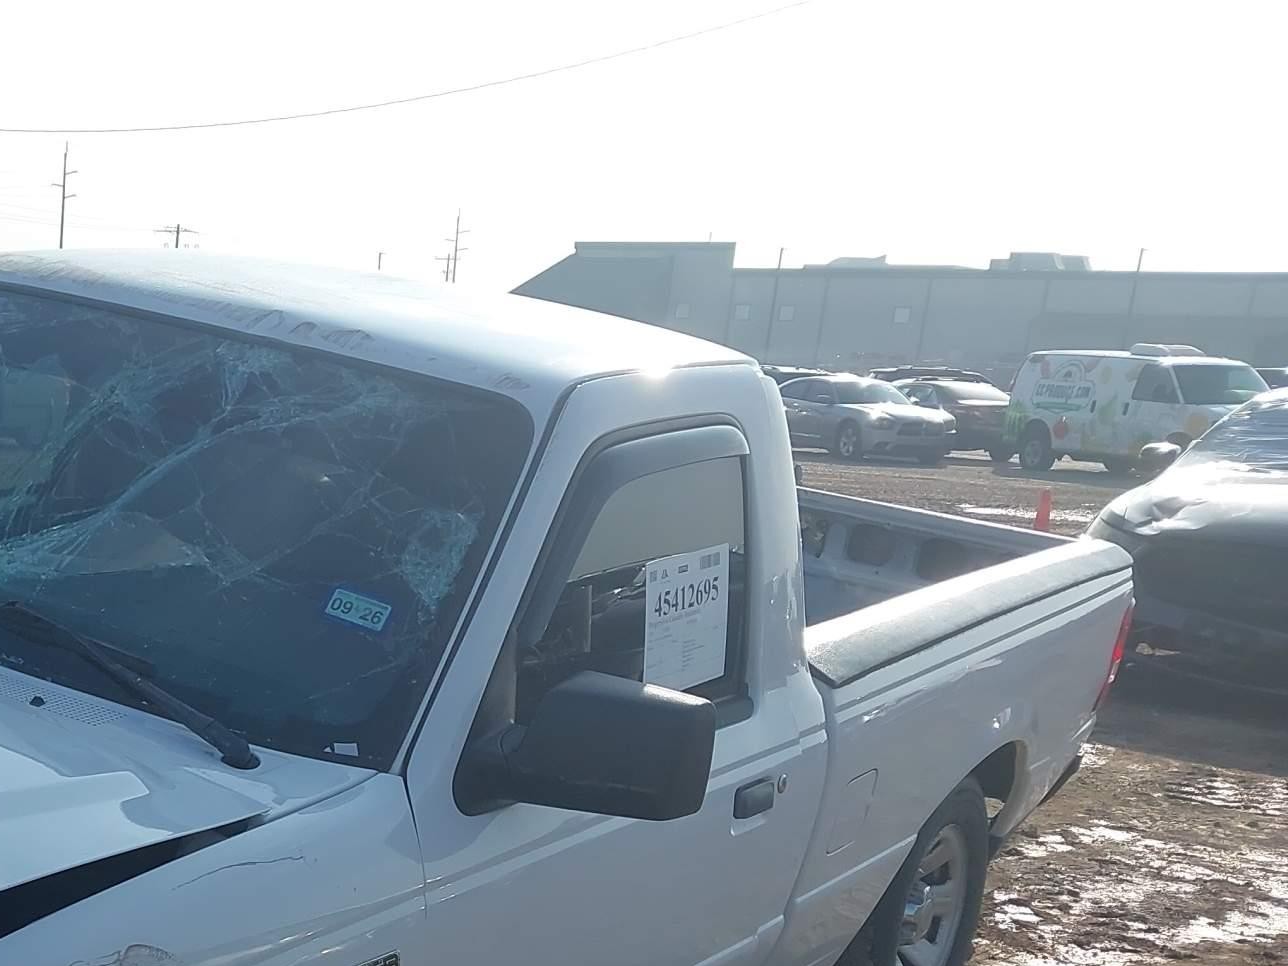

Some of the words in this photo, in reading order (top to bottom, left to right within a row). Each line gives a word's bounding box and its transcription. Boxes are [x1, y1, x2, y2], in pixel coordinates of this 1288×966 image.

[330, 597, 353, 615] 09
[358, 607, 384, 625] 26
[654, 576, 719, 618] 45412695
